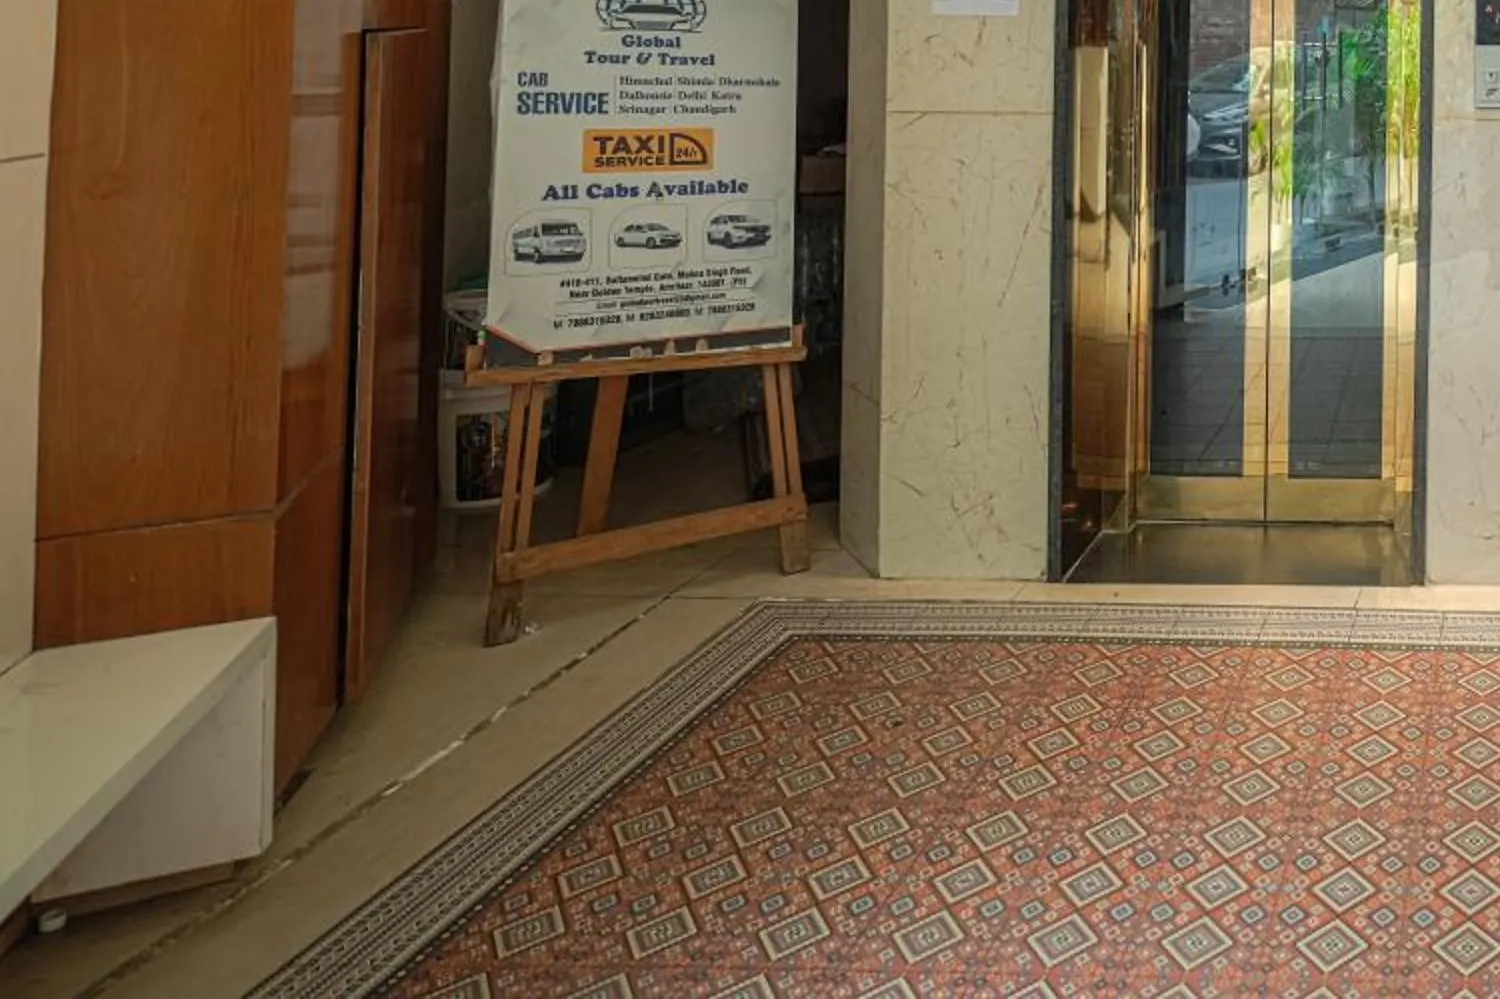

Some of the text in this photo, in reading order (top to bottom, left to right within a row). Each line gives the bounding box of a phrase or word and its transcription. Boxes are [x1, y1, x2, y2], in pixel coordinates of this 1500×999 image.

[621, 34, 682, 49] Global
[584, 51, 716, 66] Tour & Travel
[517, 72, 549, 87] CAB
[517, 91, 609, 116] SERVICE
[593, 135, 665, 154] TAXI
[594, 155, 665, 167] SERVICE
[542, 178, 749, 200] All Cabs Available
